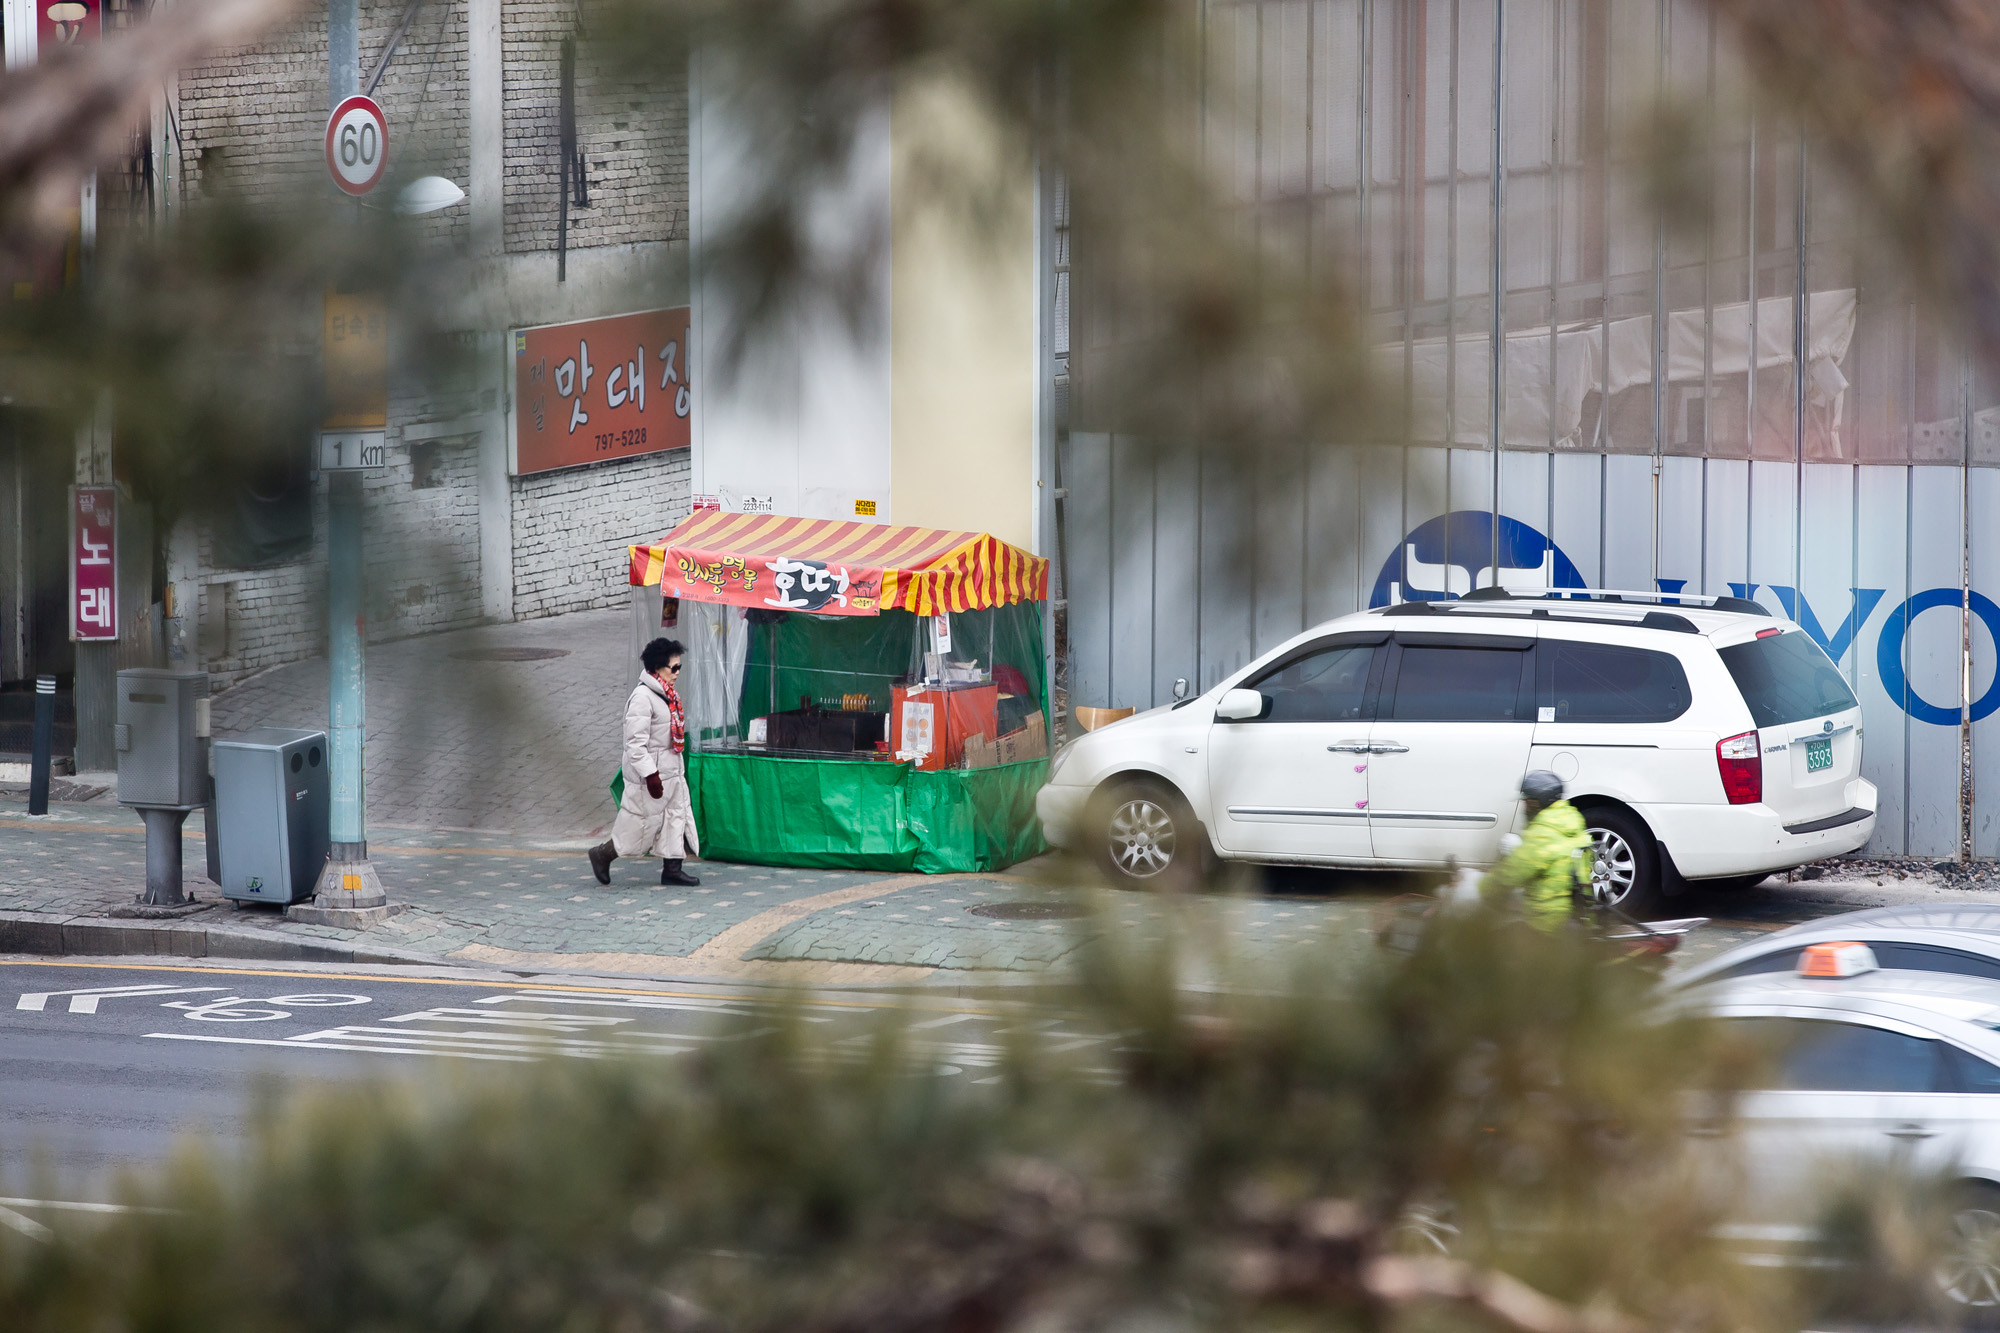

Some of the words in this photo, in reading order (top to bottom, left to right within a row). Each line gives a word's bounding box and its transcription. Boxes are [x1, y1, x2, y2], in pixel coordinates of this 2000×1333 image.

[341, 122, 377, 167] 60
[334, 441, 343, 466] 1
[360, 439, 384, 466] km
[595, 427, 647, 452] 797-5228
[80, 528, 111, 627] 노래
[677, 556, 727, 595] 인사동
[722, 555, 758, 591] 명물
[764, 556, 850, 608] 호떡
[1808, 748, 1832, 769] 3393
